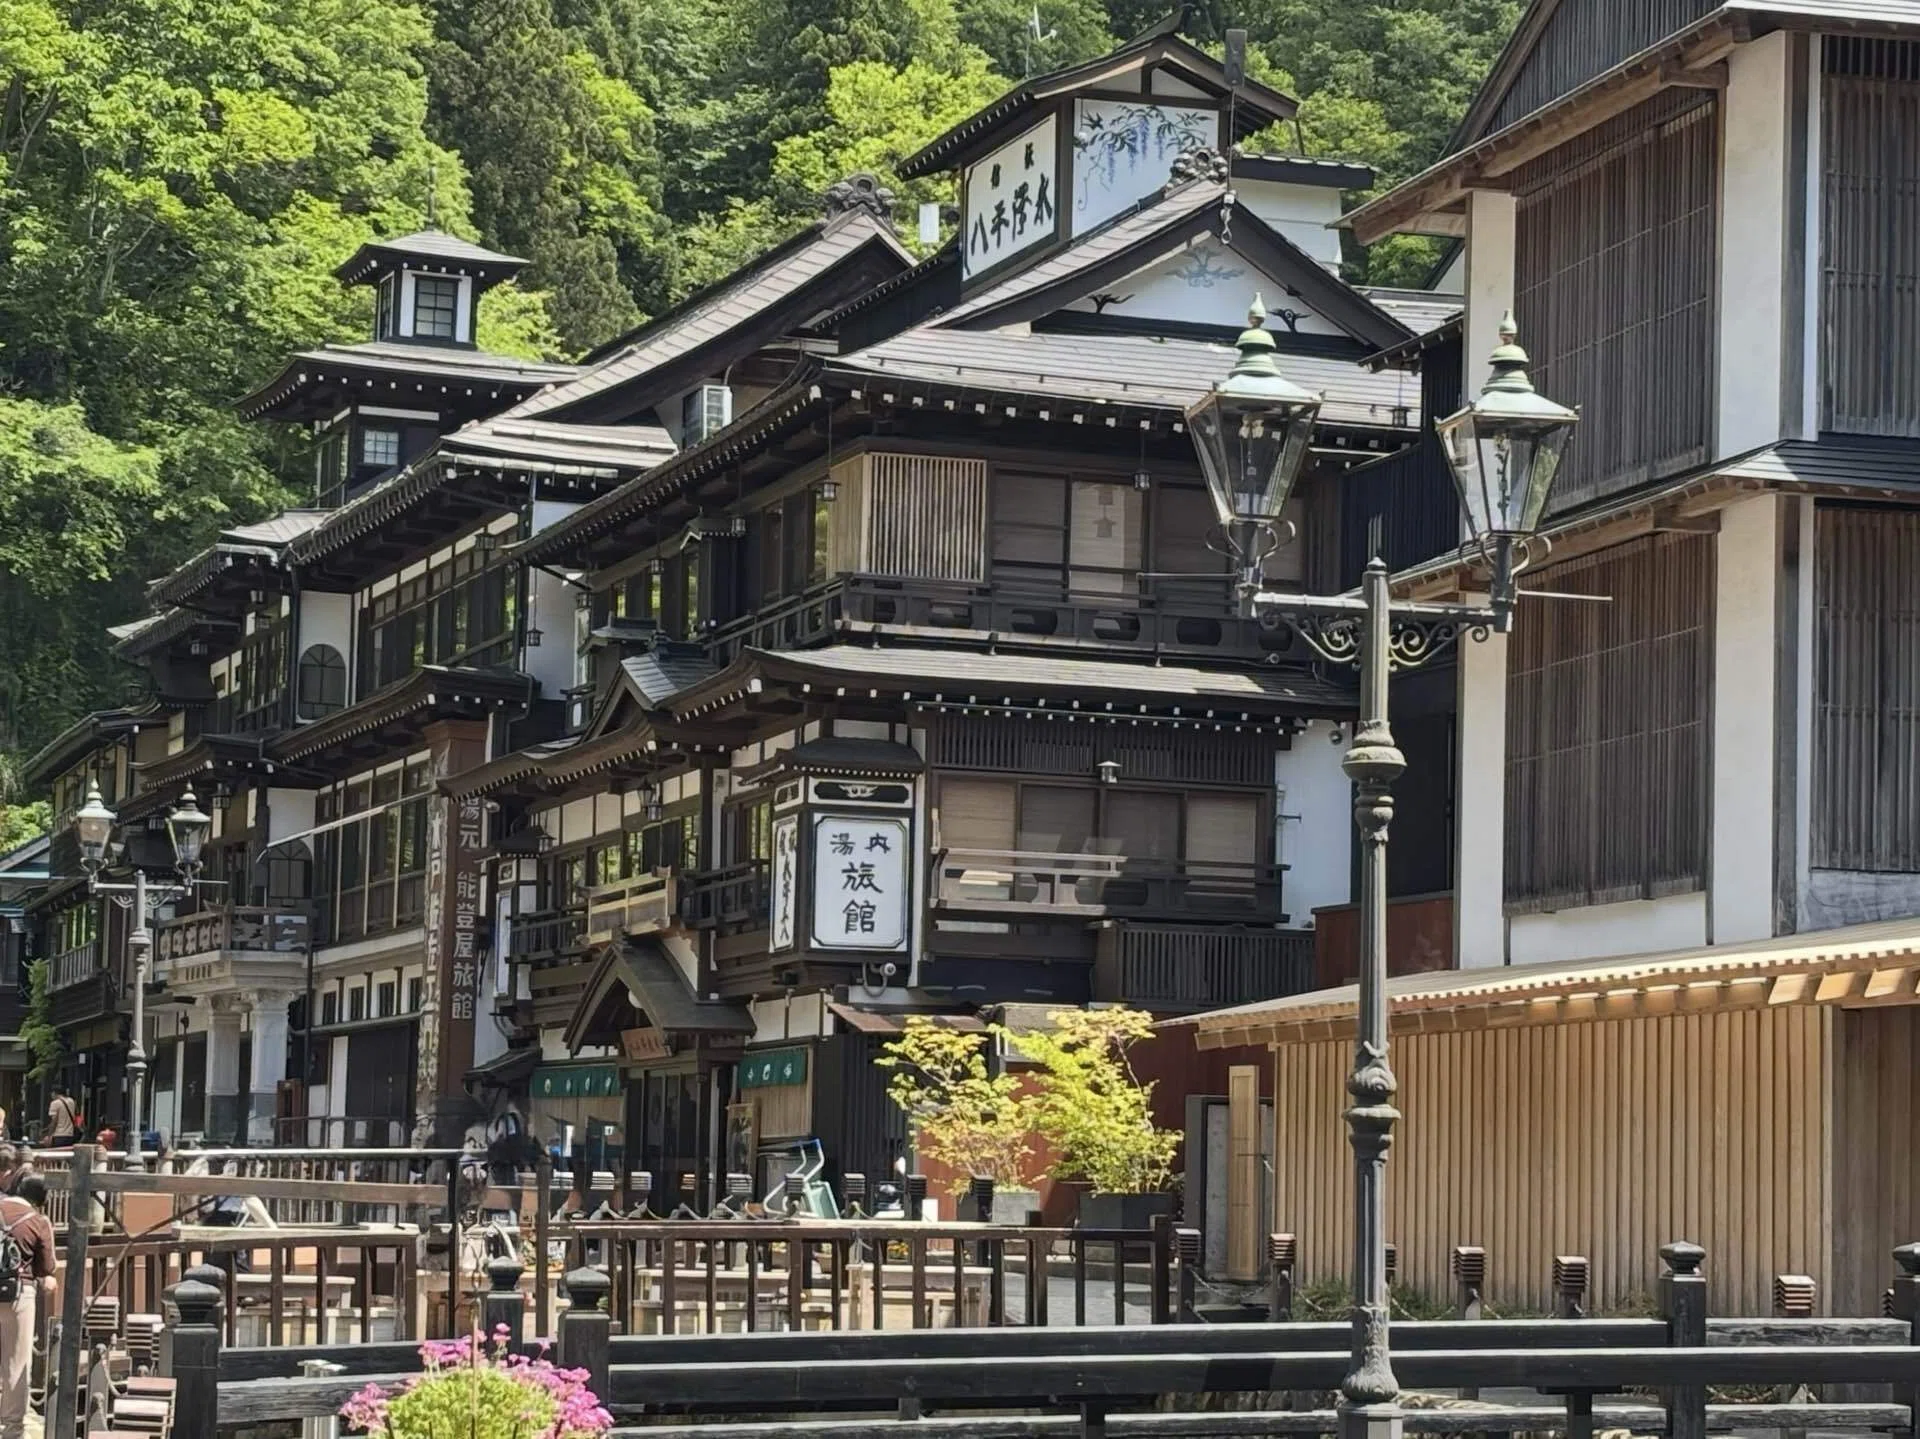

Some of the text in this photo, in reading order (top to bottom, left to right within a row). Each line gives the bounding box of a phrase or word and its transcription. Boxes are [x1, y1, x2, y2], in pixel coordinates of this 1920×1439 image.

[829, 832, 891, 856] 内湯
[451, 795, 481, 1019] 湯元 能登屋旅館
[841, 861, 884, 935] 旅館
